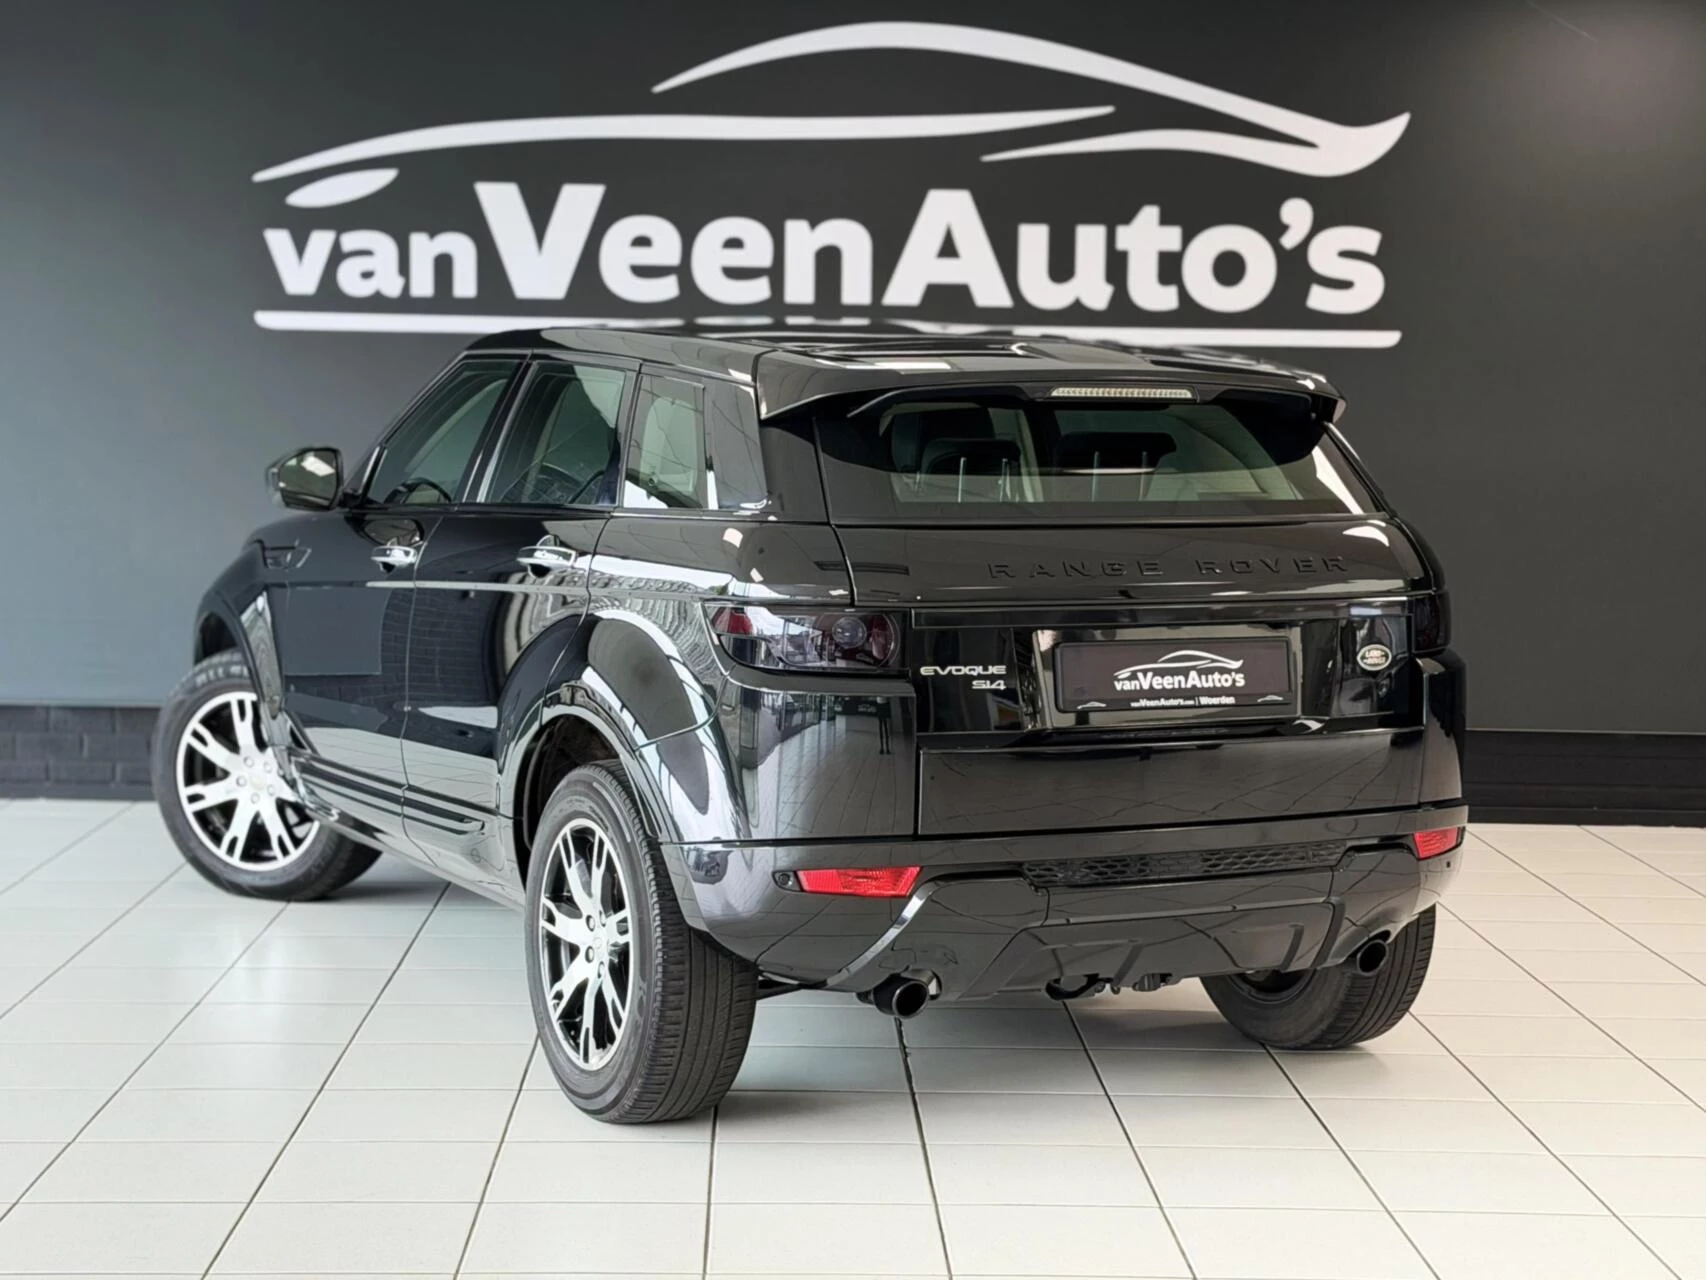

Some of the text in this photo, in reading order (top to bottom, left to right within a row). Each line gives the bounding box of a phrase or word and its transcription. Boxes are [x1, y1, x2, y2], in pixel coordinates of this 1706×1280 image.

[986, 555, 1349, 579] RANGE ROVER
[920, 665, 1007, 676] EVOQUE
